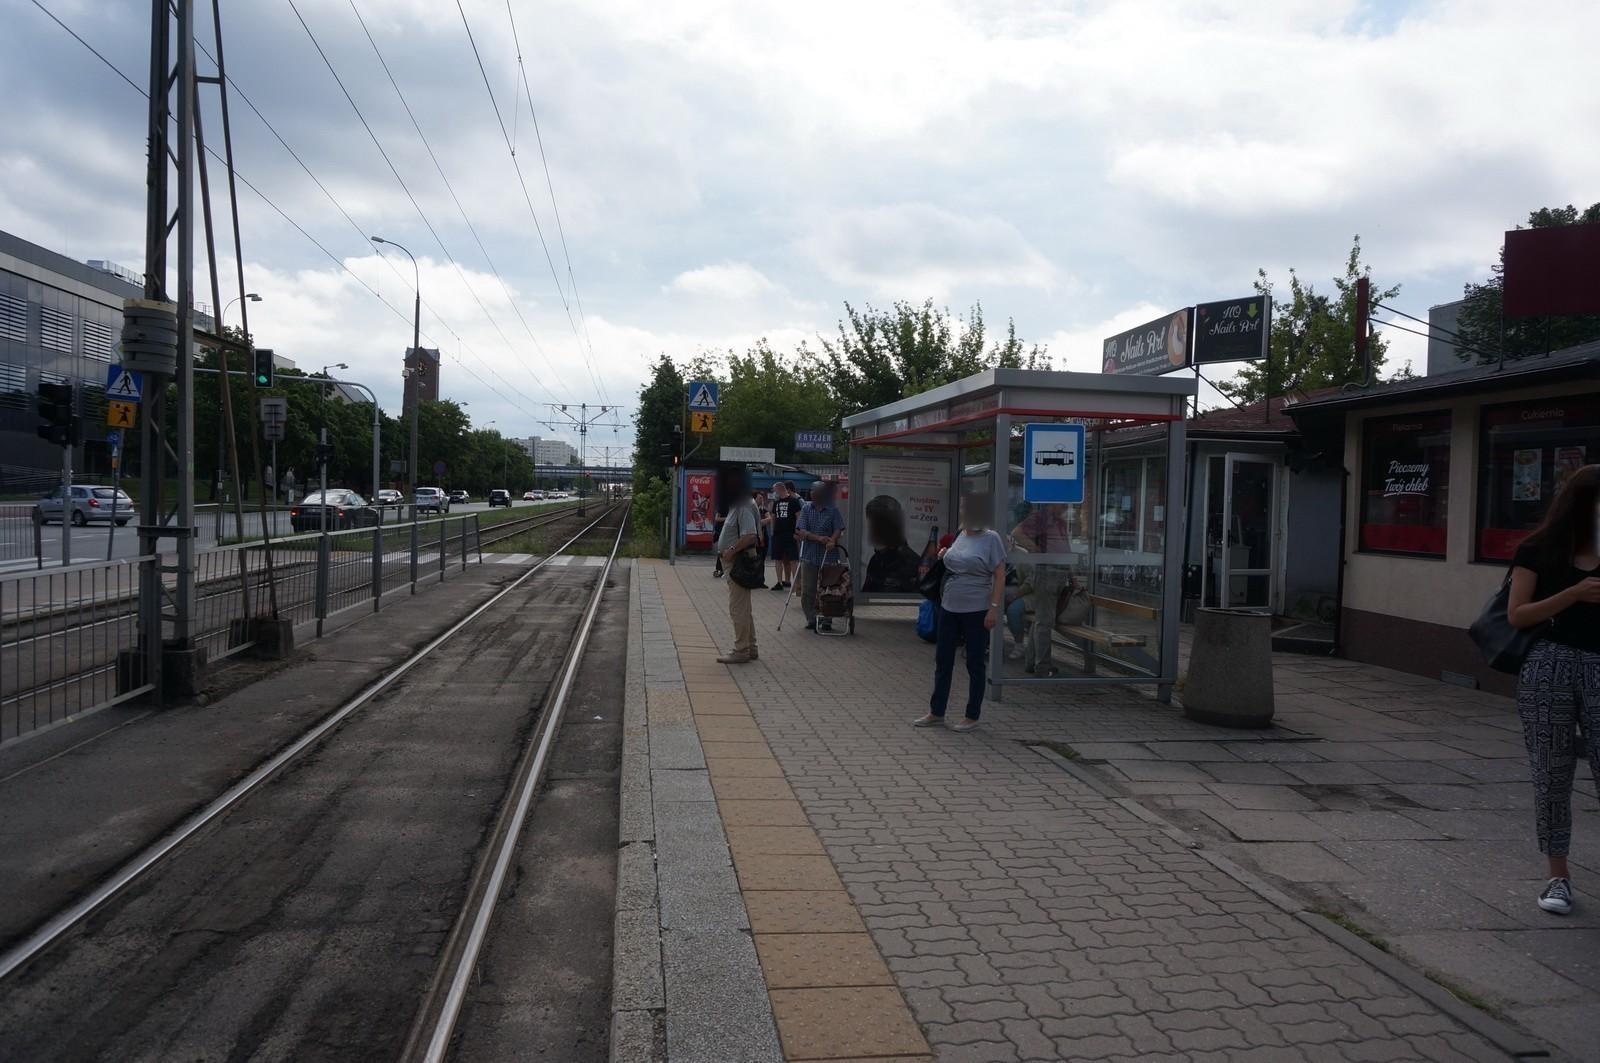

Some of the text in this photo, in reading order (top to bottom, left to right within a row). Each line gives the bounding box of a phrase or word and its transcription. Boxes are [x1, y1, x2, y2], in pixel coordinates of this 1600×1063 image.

[1209, 319, 1259, 335] Nails Art
[1120, 326, 1166, 362] Nails Art
[798, 433, 831, 442] FRYZJER
[1388, 460, 1429, 477] Pieczemy
[1385, 478, 1429, 495] Twój chleb
